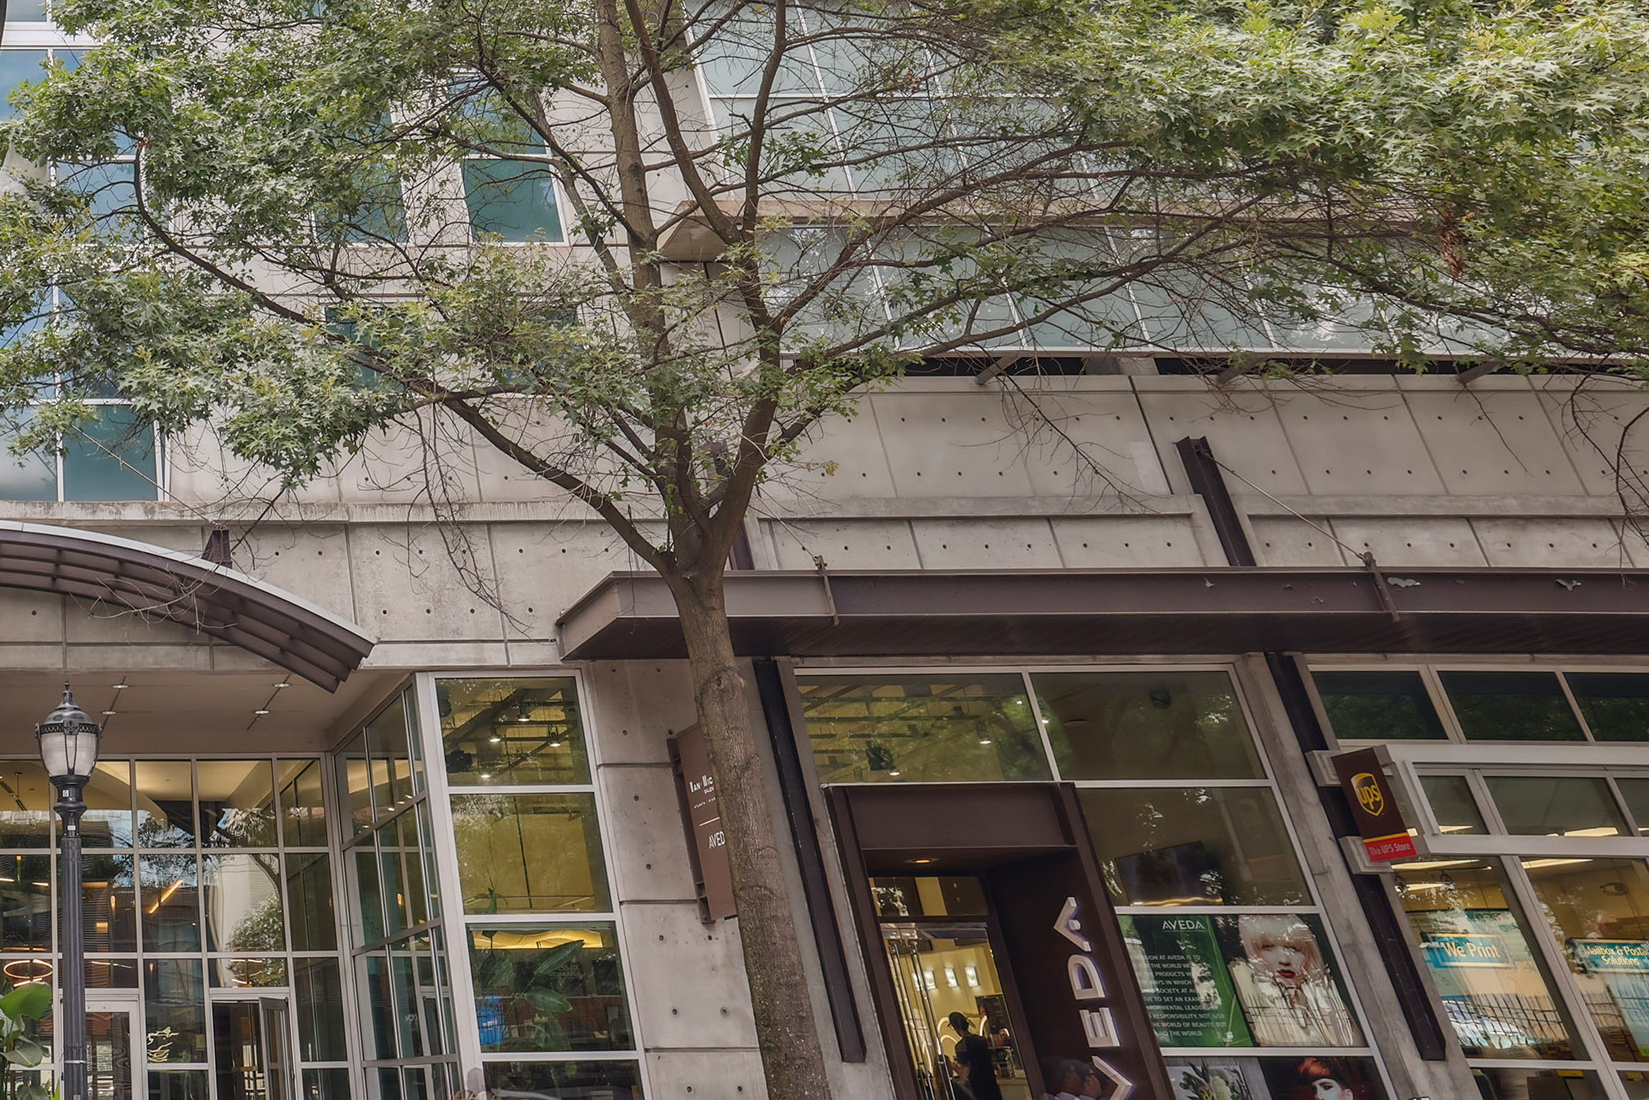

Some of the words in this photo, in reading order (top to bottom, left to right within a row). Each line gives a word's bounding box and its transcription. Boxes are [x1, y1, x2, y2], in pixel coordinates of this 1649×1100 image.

[1359, 785, 1381, 810] ups
[1368, 846, 1381, 855] The
[1381, 843, 1394, 853] UPS
[1394, 842, 1411, 852] Store
[1162, 920, 1205, 930] AVEDA
[1440, 942, 1466, 957] We
[1466, 942, 1501, 958] Print
[1601, 956, 1641, 966] Solutions
